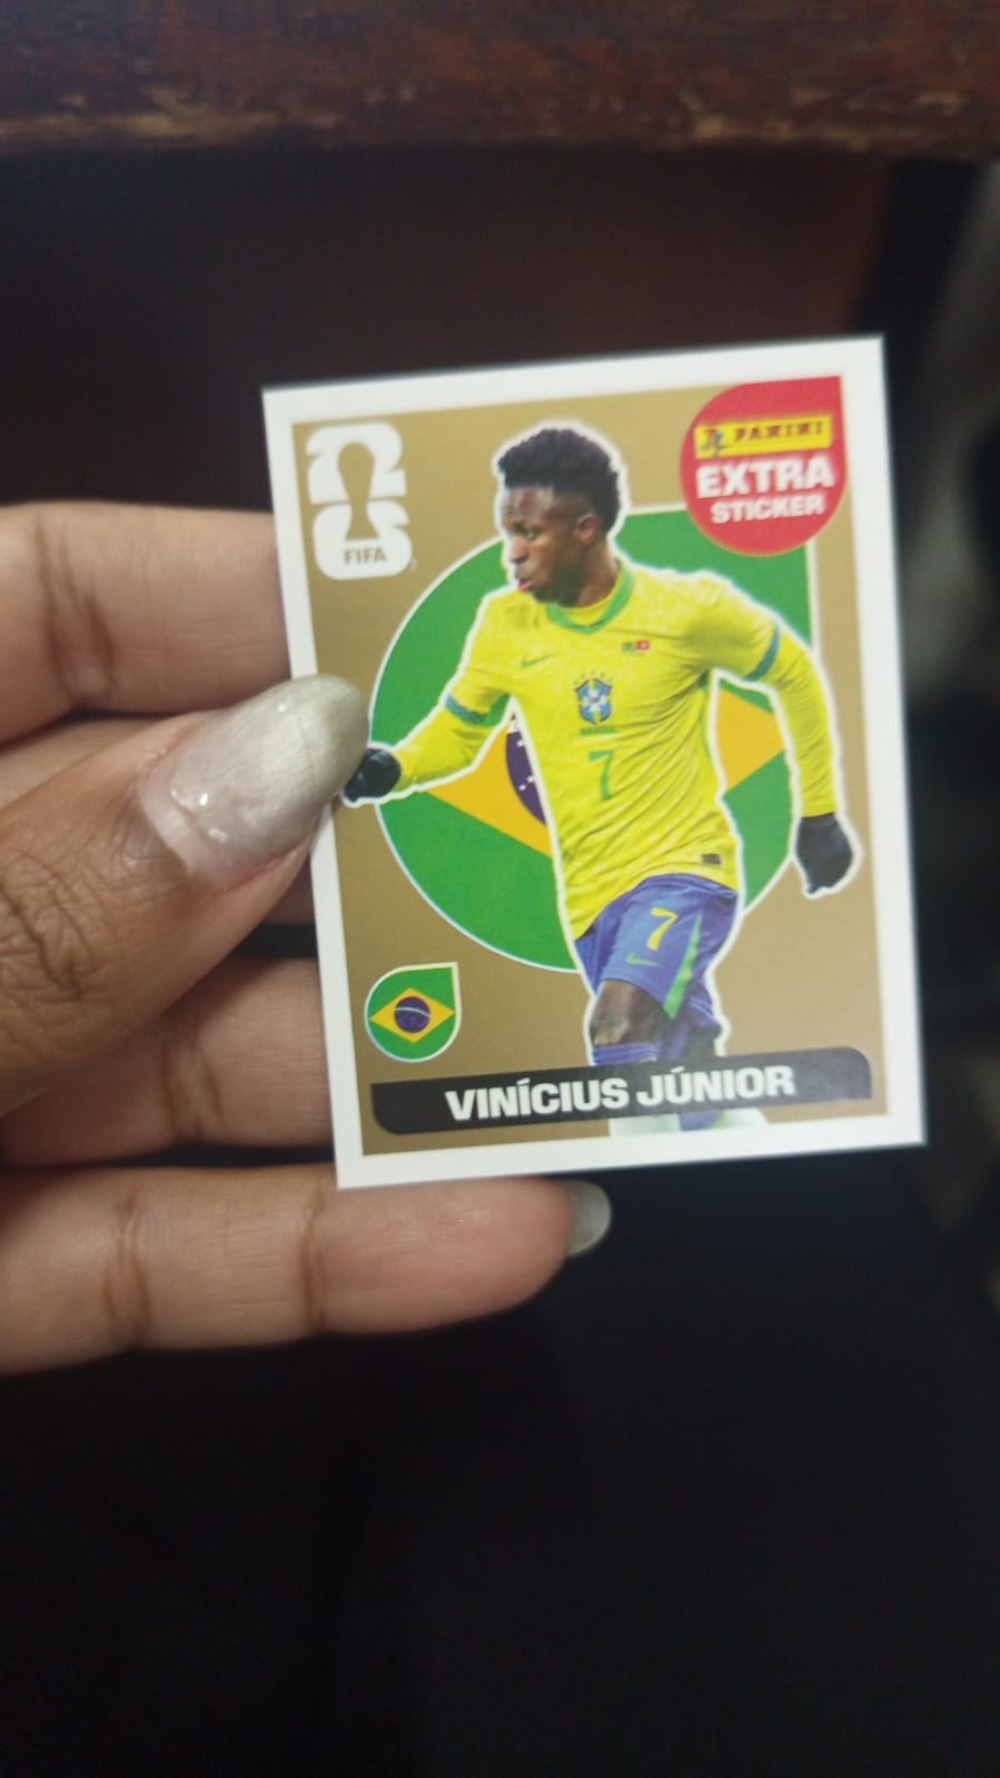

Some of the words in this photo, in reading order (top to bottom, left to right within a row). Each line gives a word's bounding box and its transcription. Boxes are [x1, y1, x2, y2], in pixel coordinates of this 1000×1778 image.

[734, 421, 824, 442] PANINI
[695, 455, 835, 498] EXTRA
[710, 494, 826, 524] STICKER
[343, 547, 387, 565] FIFA
[589, 750, 614, 800] 7
[646, 906, 679, 951] 7
[445, 1078, 629, 1121] VINÍCIUS
[636, 1065, 796, 1107] JÚNIOR
